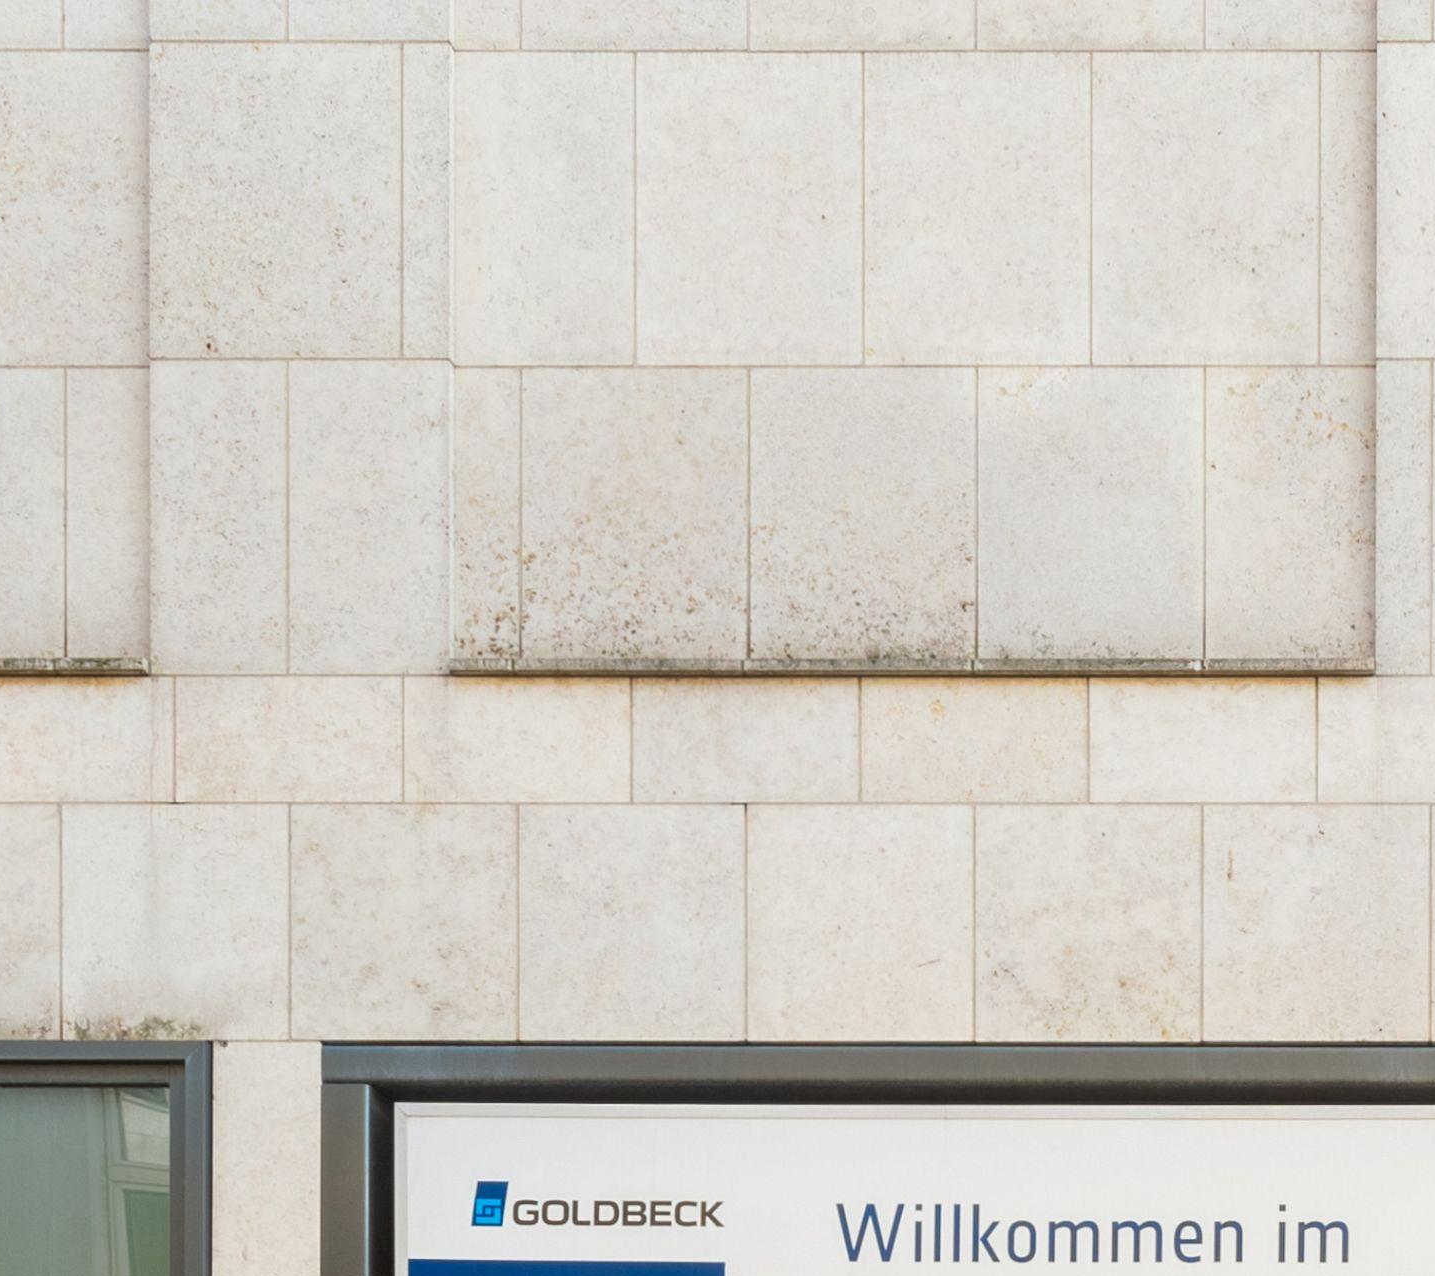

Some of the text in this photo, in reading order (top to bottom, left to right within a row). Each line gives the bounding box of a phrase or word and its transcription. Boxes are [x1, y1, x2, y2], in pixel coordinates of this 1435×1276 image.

[510, 1196, 727, 1230] GOLDBECK
[833, 1198, 1355, 1266] Willkommen im
